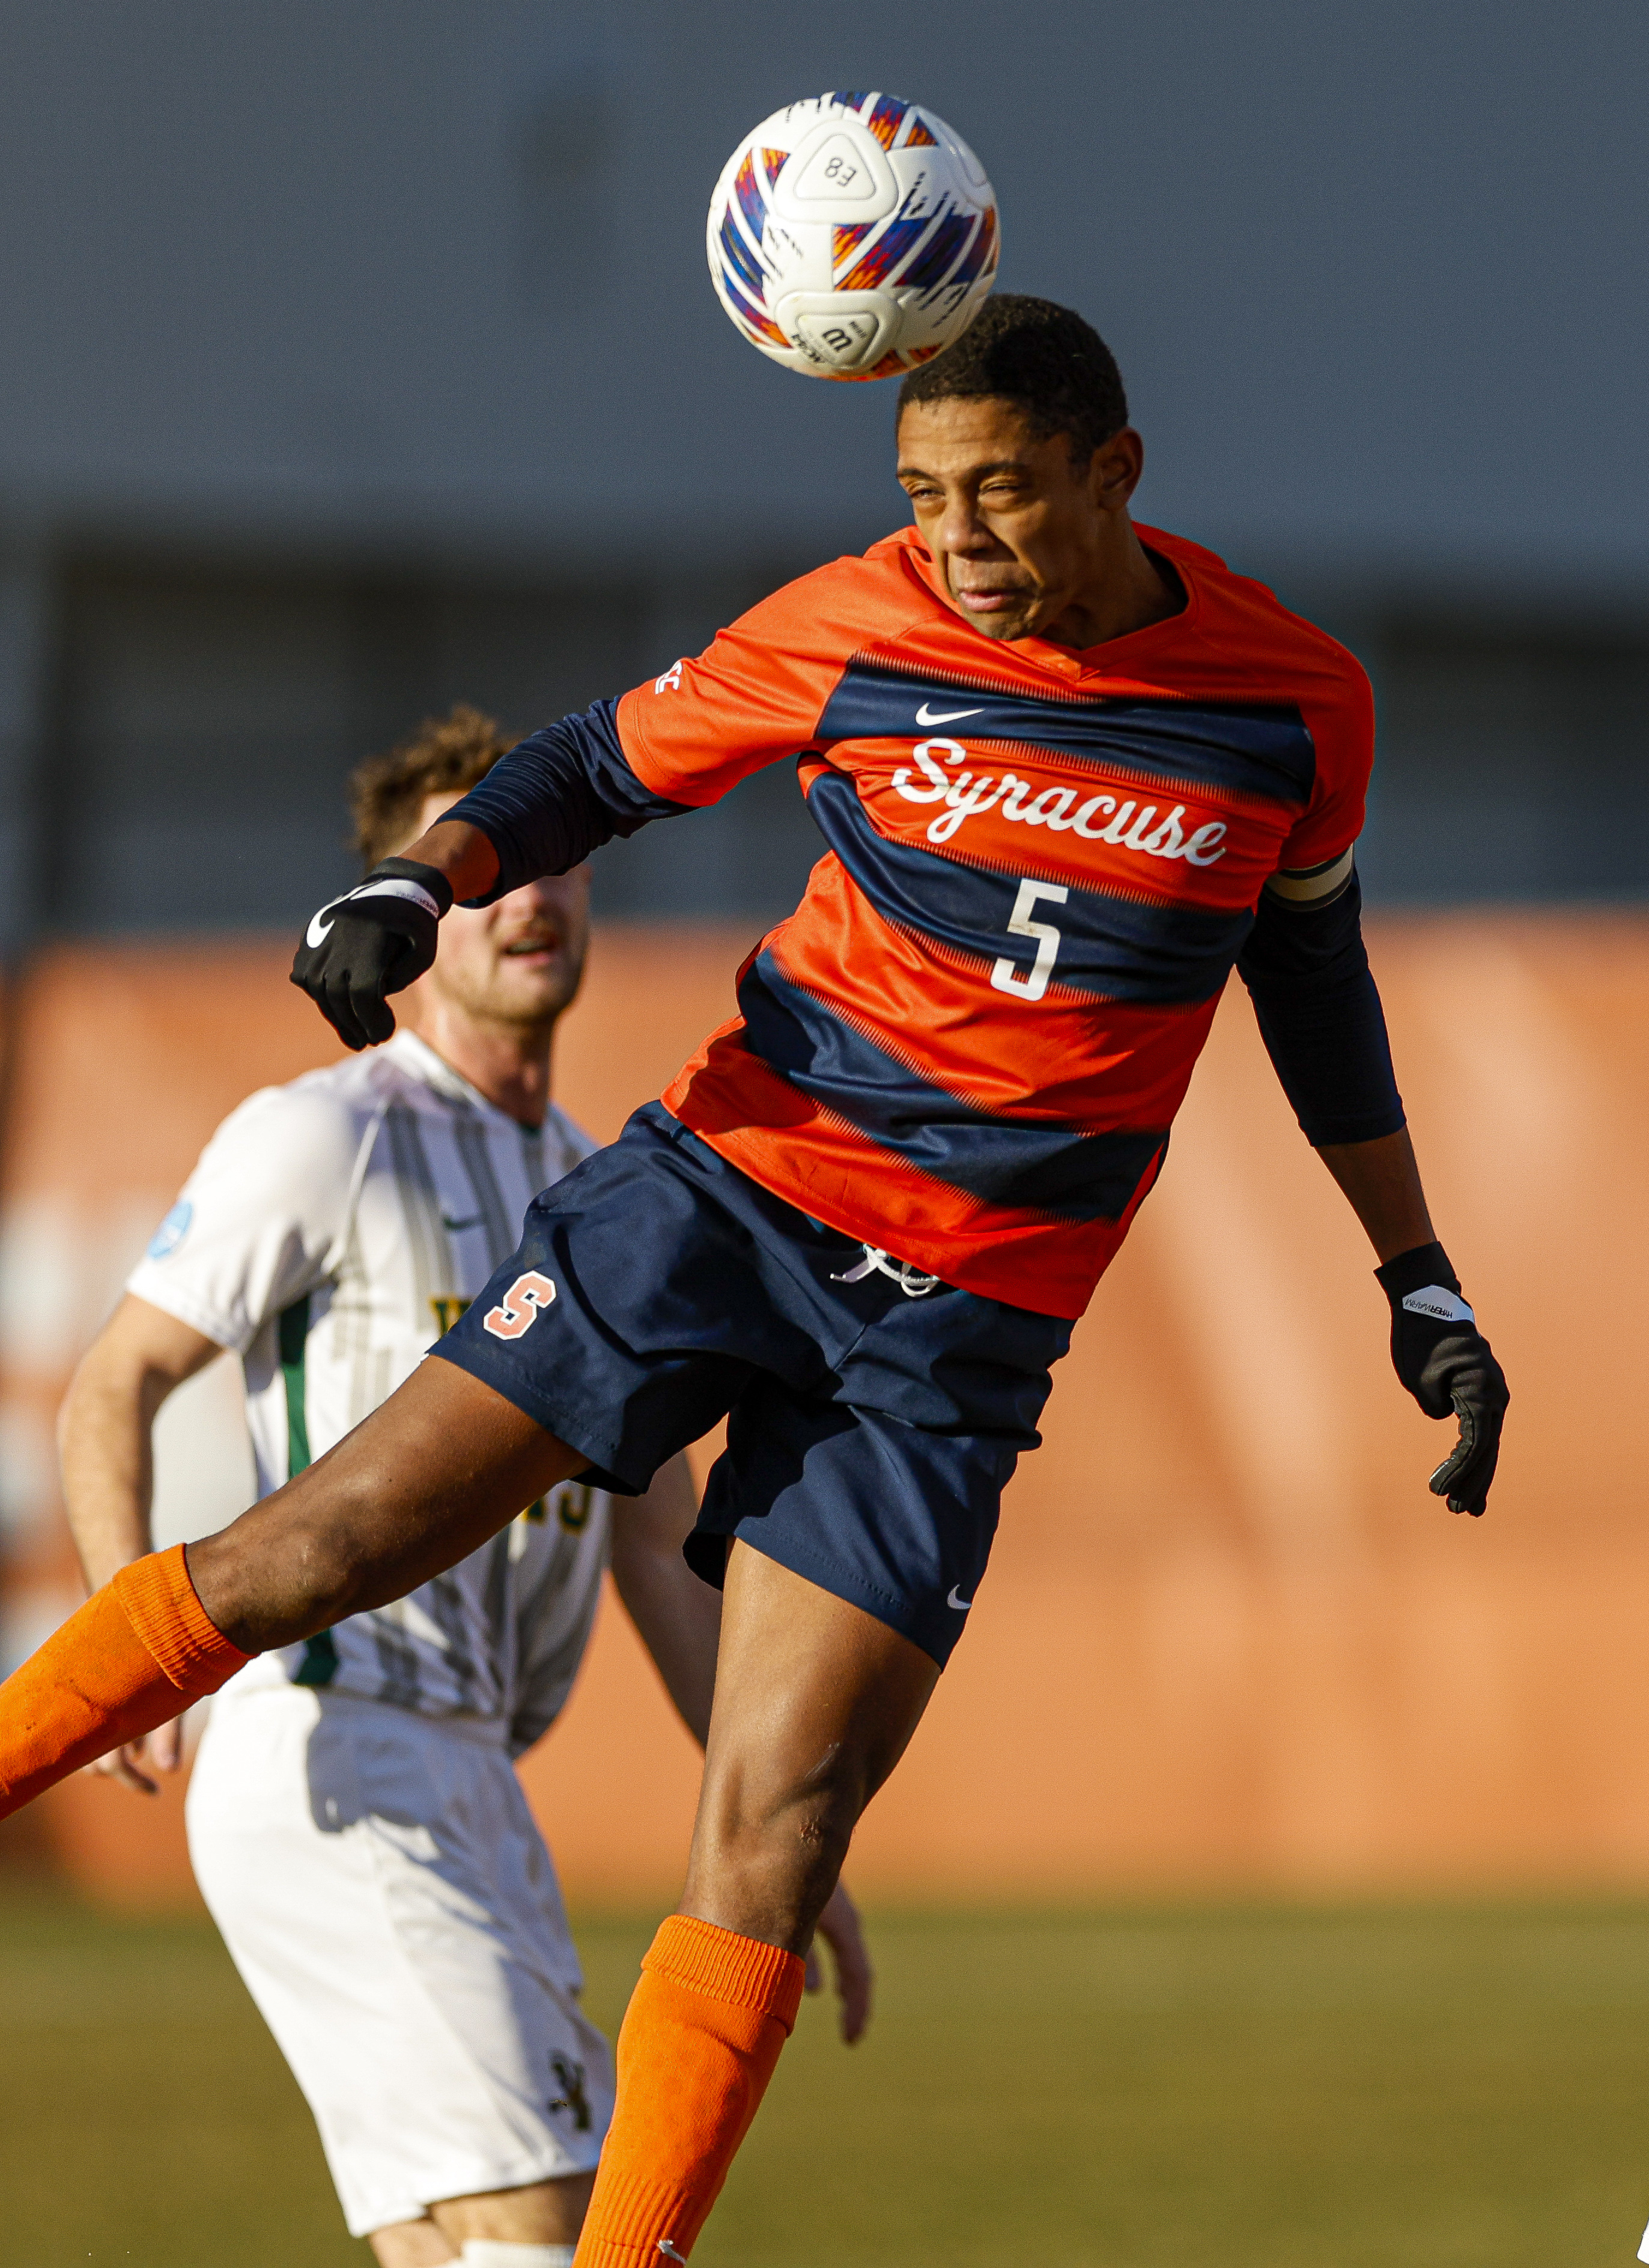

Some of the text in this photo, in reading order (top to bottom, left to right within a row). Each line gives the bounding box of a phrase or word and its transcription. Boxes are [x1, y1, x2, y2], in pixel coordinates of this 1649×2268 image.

[891, 738, 1227, 866] Syracuse
[991, 878, 1069, 1002] 5
[484, 1270, 556, 1340] S
[1405, 1298, 1453, 1319] HYPERWARM
